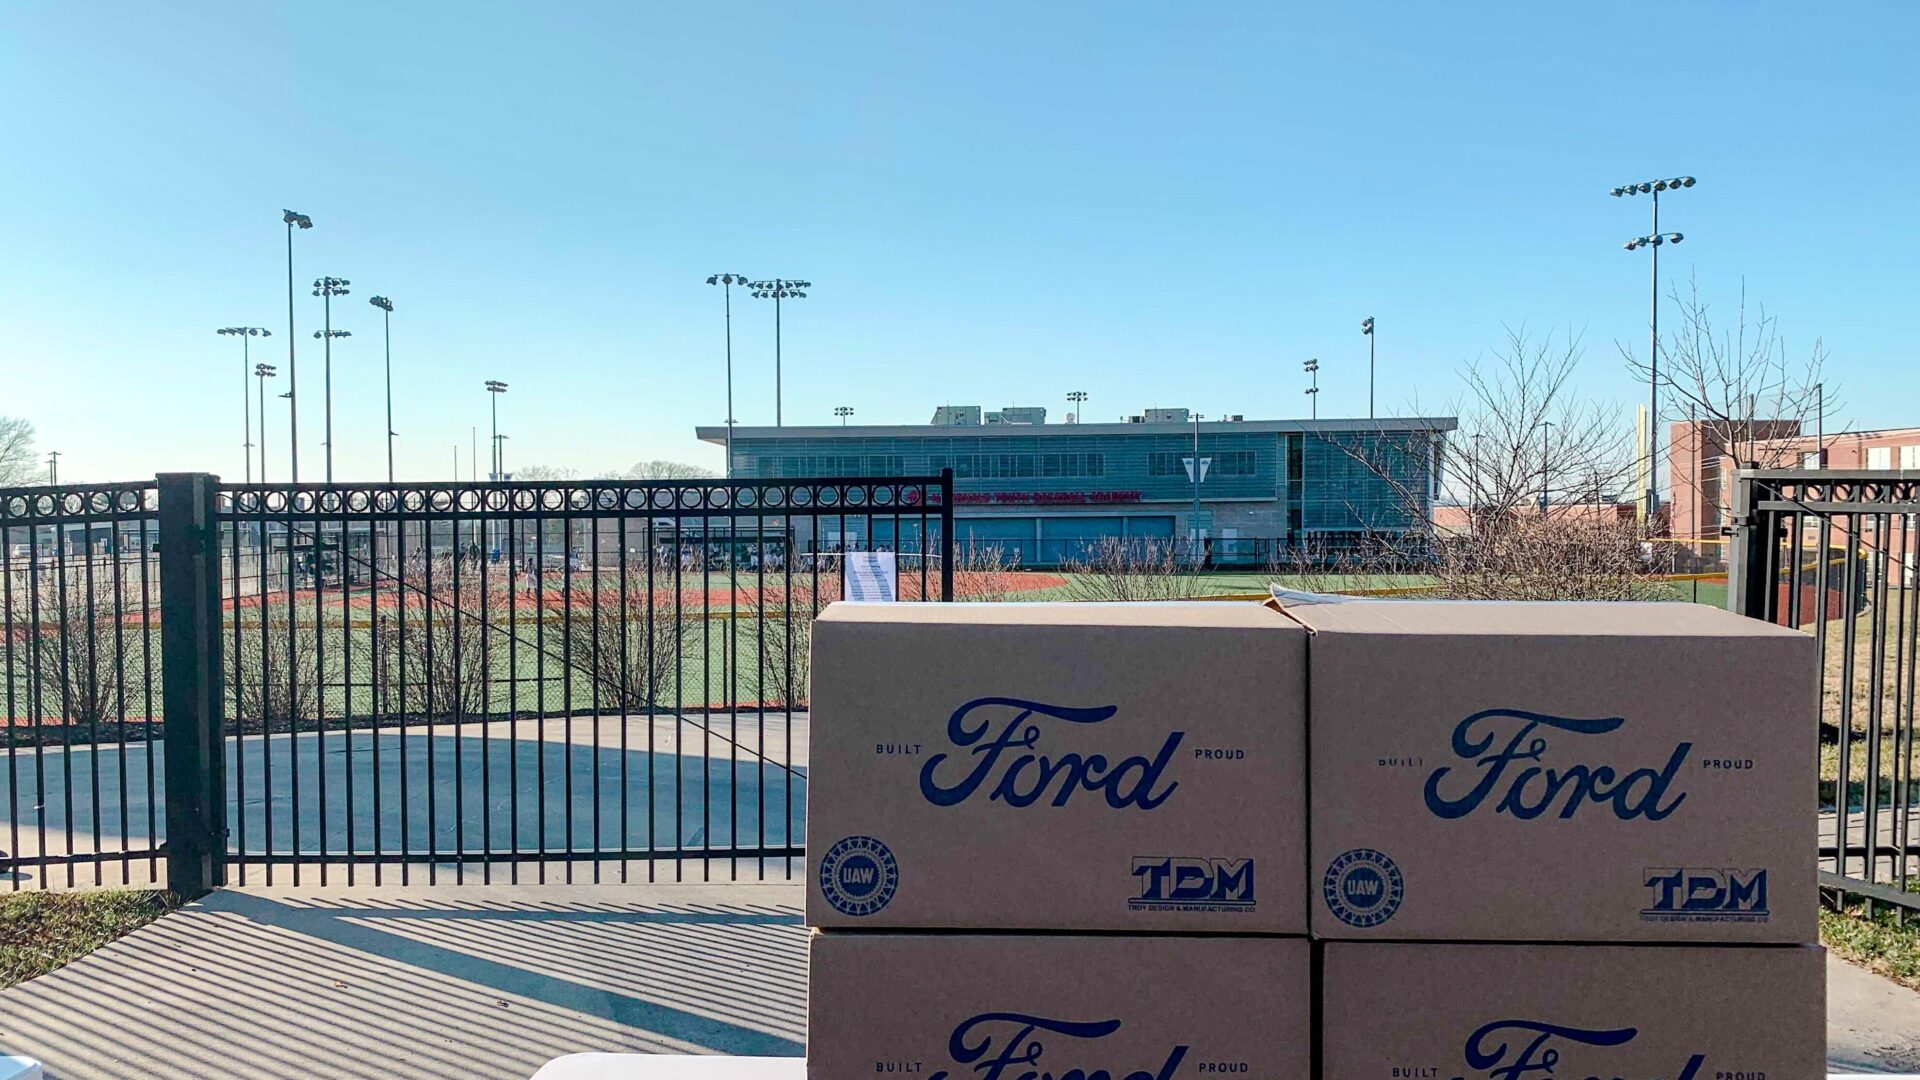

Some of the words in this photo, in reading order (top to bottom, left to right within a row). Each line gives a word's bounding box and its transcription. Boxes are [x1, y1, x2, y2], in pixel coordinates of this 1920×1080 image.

[876, 744, 922, 754] BUILT
[919, 696, 1185, 810] Ford
[1195, 749, 1245, 759] PROUD
[1423, 708, 1693, 821] Ford
[1703, 759, 1753, 769] PROUD
[843, 868, 874, 884] UAW
[1131, 856, 1254, 900] TDM
[1347, 879, 1378, 895] UAW
[1643, 867, 1766, 910] TDM
[876, 1062, 922, 1072] BUILT
[1199, 1063, 1249, 1073] PROUD
[1392, 1067, 1438, 1078] BUILT
[1716, 1072, 1766, 1080] PROUD
